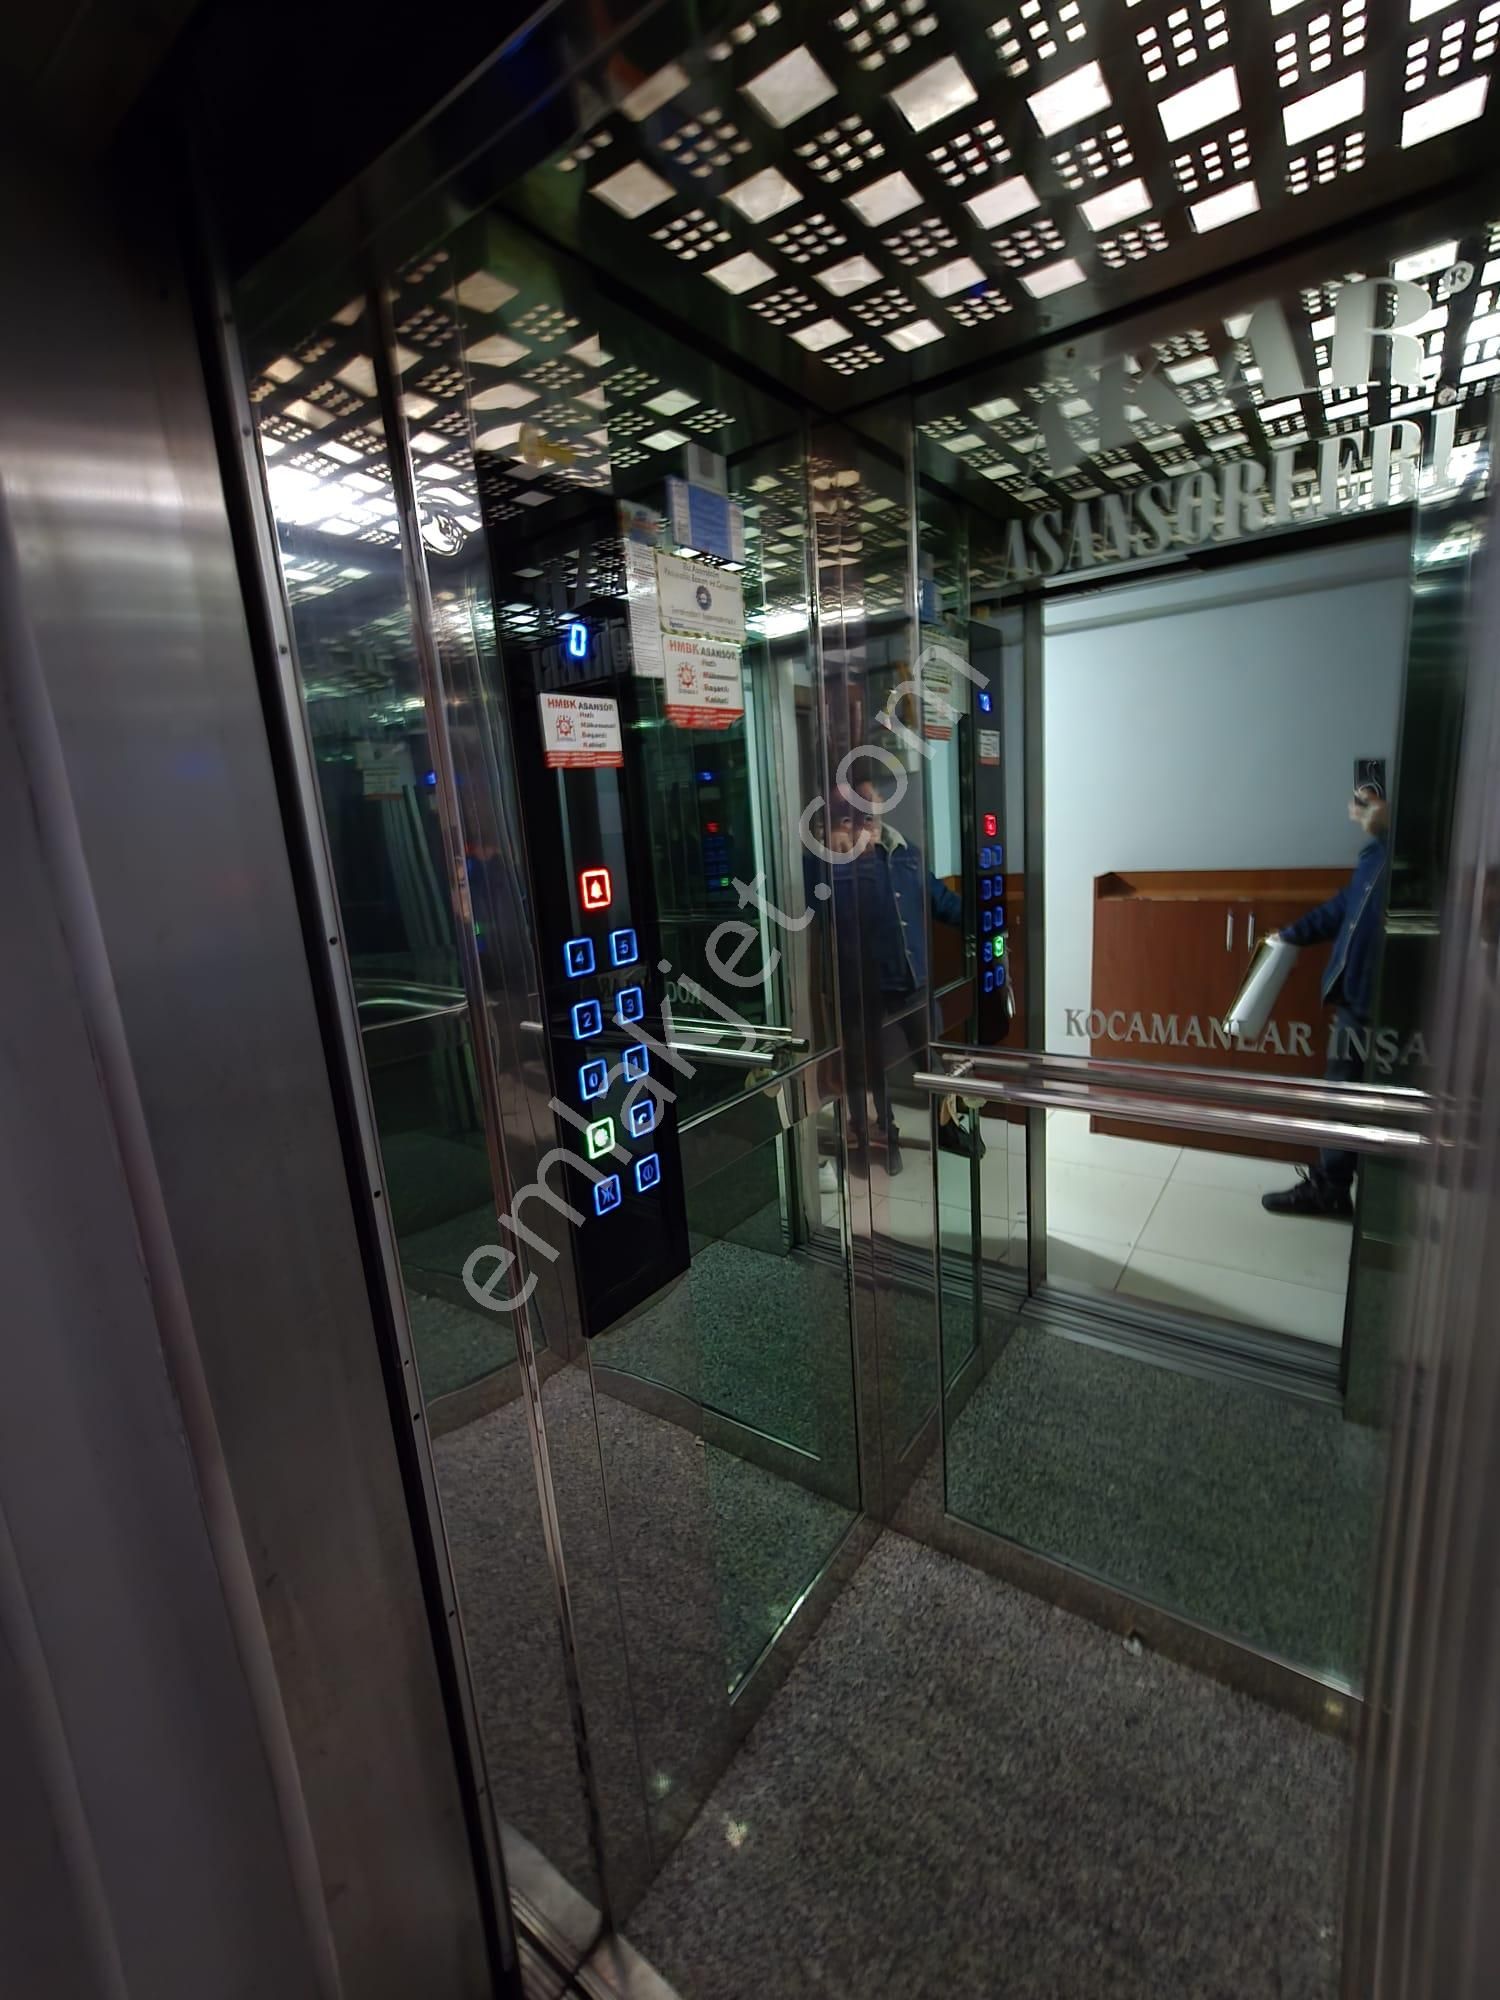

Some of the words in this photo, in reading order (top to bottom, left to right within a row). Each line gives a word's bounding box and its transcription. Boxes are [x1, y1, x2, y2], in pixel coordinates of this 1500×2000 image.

[569, 622, 587, 657] 0
[668, 640, 699, 655] HMBK
[547, 697, 577, 710] HMBK
[1063, 1008, 1315, 1058] KOCAMANLAR
